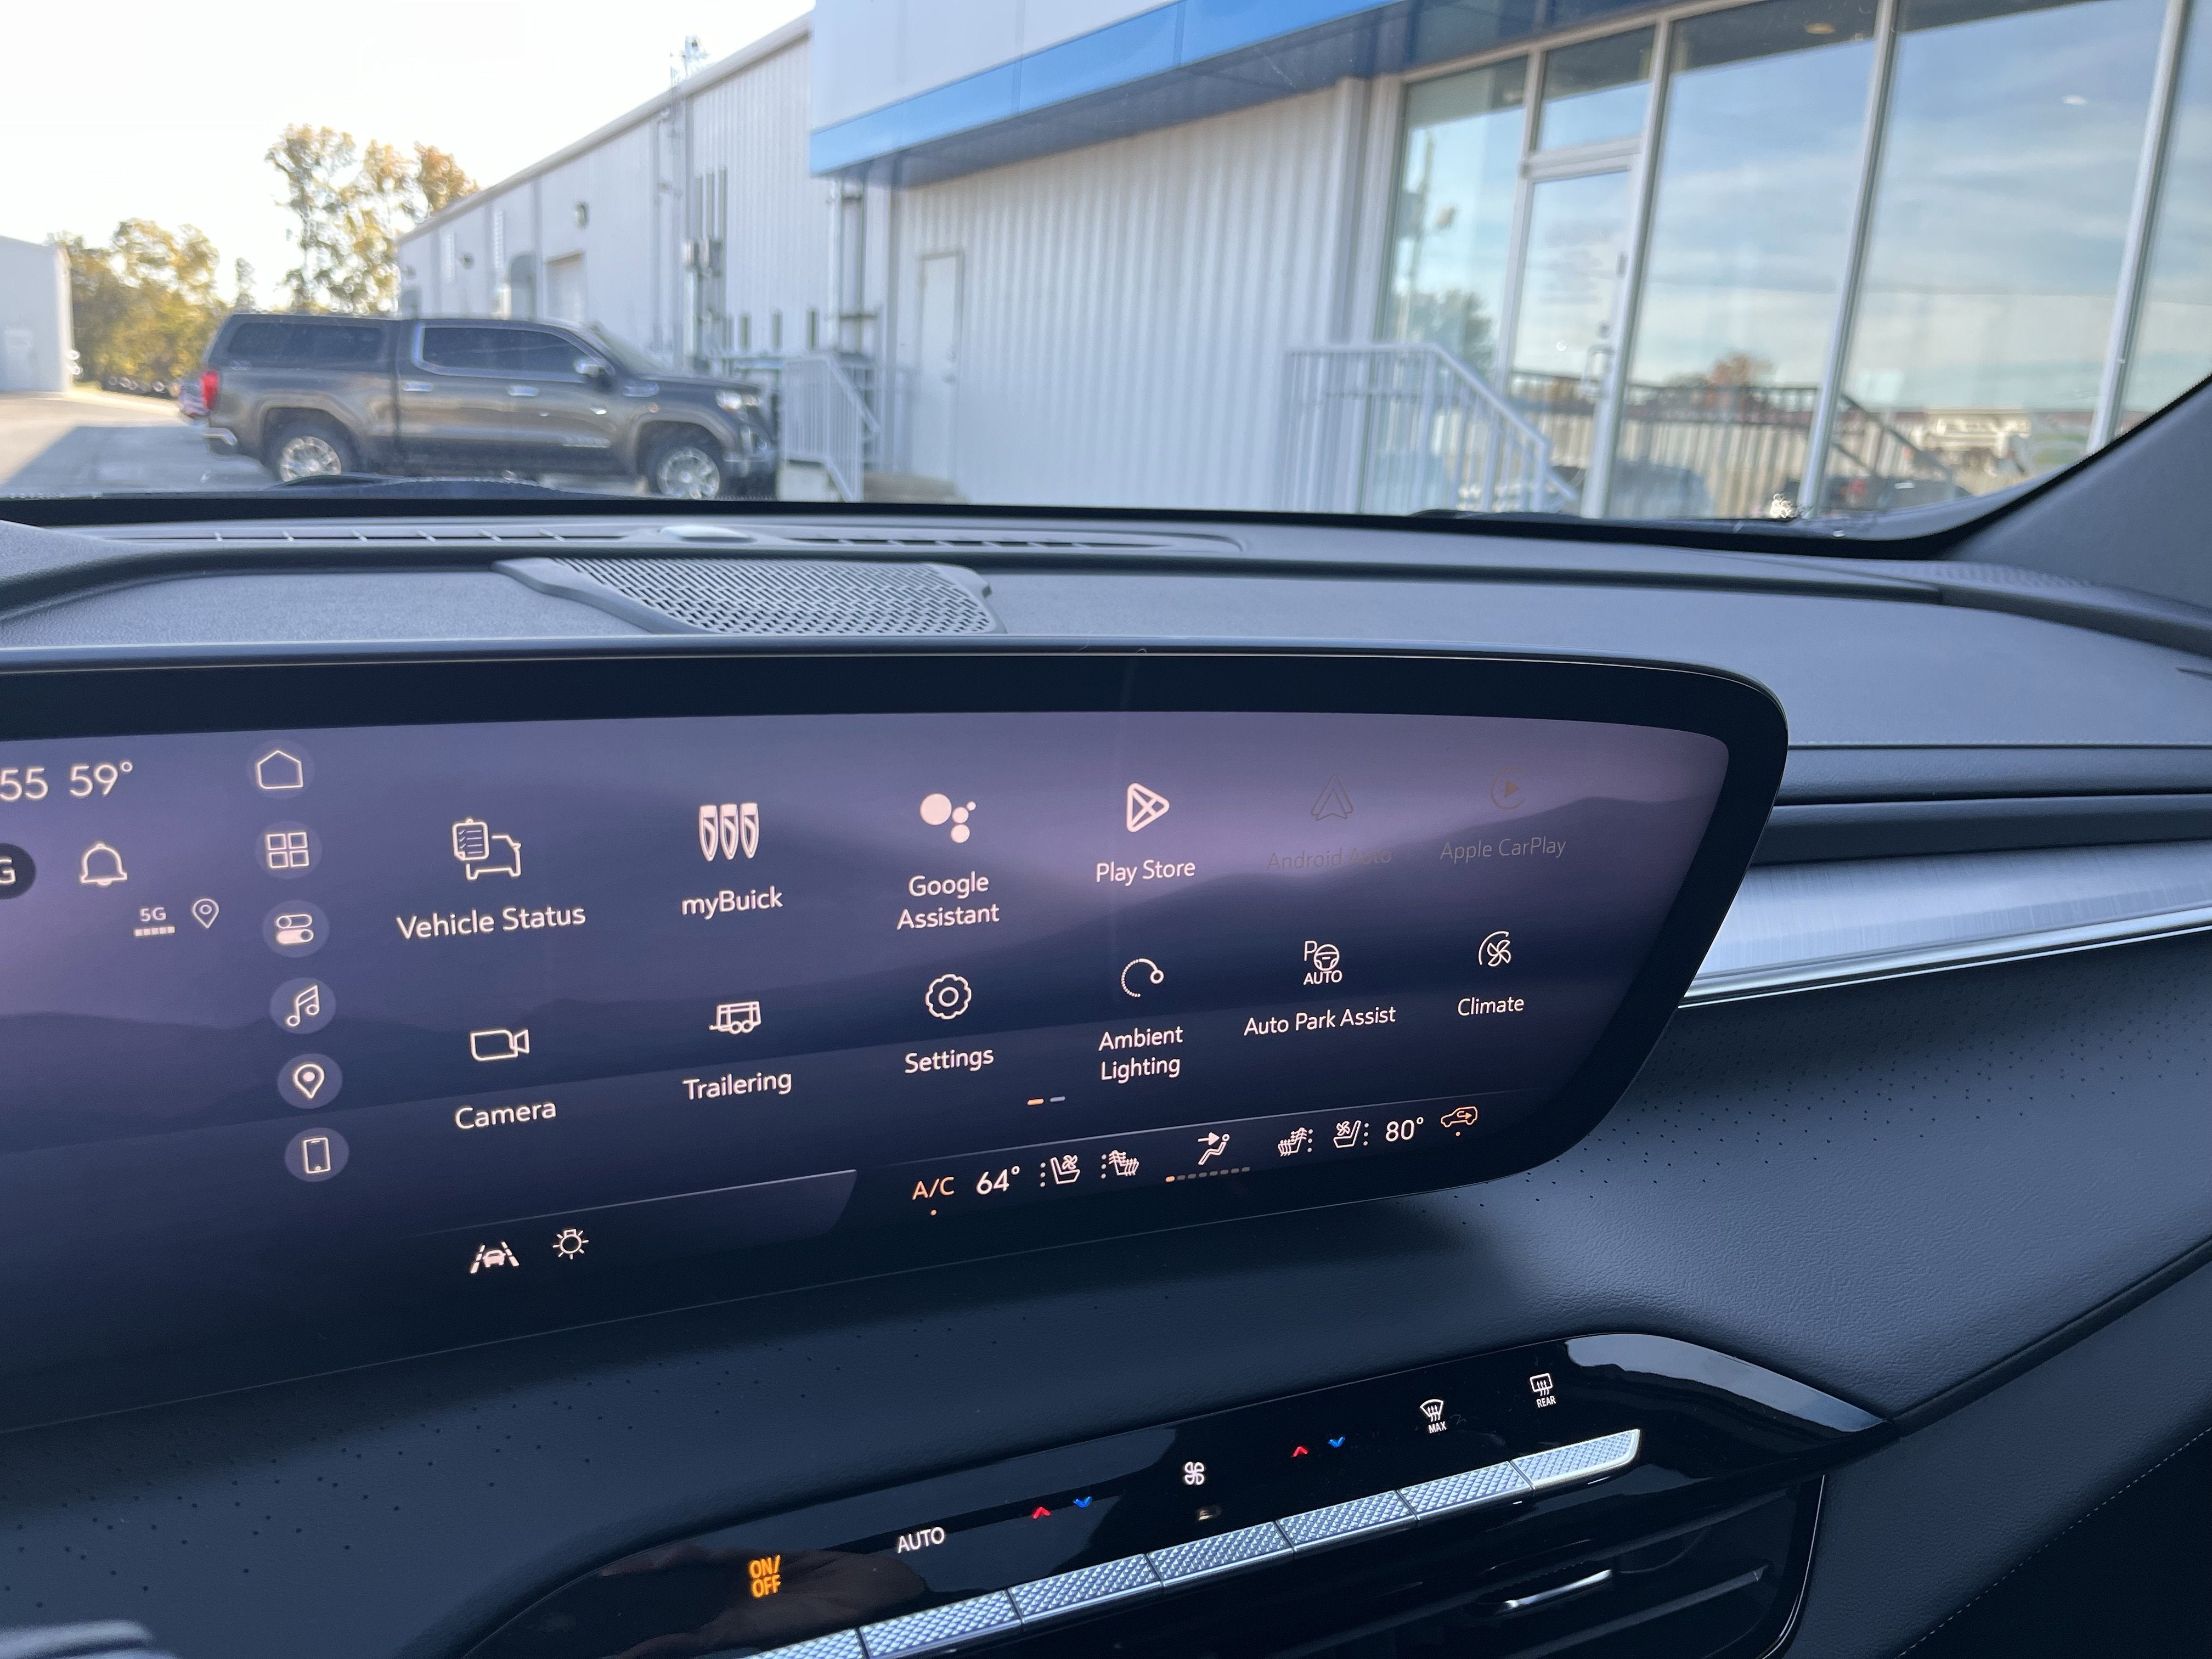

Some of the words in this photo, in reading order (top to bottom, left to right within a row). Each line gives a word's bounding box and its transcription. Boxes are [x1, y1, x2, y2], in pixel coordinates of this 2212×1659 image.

[70, 761, 133, 797] 59°
[1267, 849, 1343, 870] Android
[1440, 840, 1493, 863] Apple
[1498, 836, 1567, 857] CarPlay
[909, 871, 989, 899] Google
[1097, 861, 1138, 887] Play
[1142, 859, 1195, 879] Store
[140, 907, 166, 922] 5G
[682, 885, 783, 920] myBuick
[396, 910, 495, 939] Vehicle
[502, 906, 586, 930] Status
[897, 904, 1000, 930] Assistant
[1303, 969, 1342, 985] AUTO
[1458, 996, 1525, 1016] Climate
[1244, 1017, 1289, 1036] Auto
[1295, 1009, 1336, 1031] Park
[1339, 1006, 1396, 1027] Assist
[1098, 1026, 1183, 1051] Ambient
[905, 1049, 994, 1074] Settings
[1101, 1057, 1180, 1084] Lighting
[682, 1072, 792, 1100] Trailering
[455, 1103, 556, 1129] Camera
[912, 1176, 955, 1200] A/C
[976, 1165, 1020, 1195] 64°
[1385, 1116, 1424, 1142] 80°
[1536, 1395, 1556, 1408] REAR
[1428, 1421, 1447, 1434] MAX
[898, 1526, 945, 1554] AUTO
[749, 1555, 781, 1579] ON/
[752, 1575, 781, 1599] OFF
